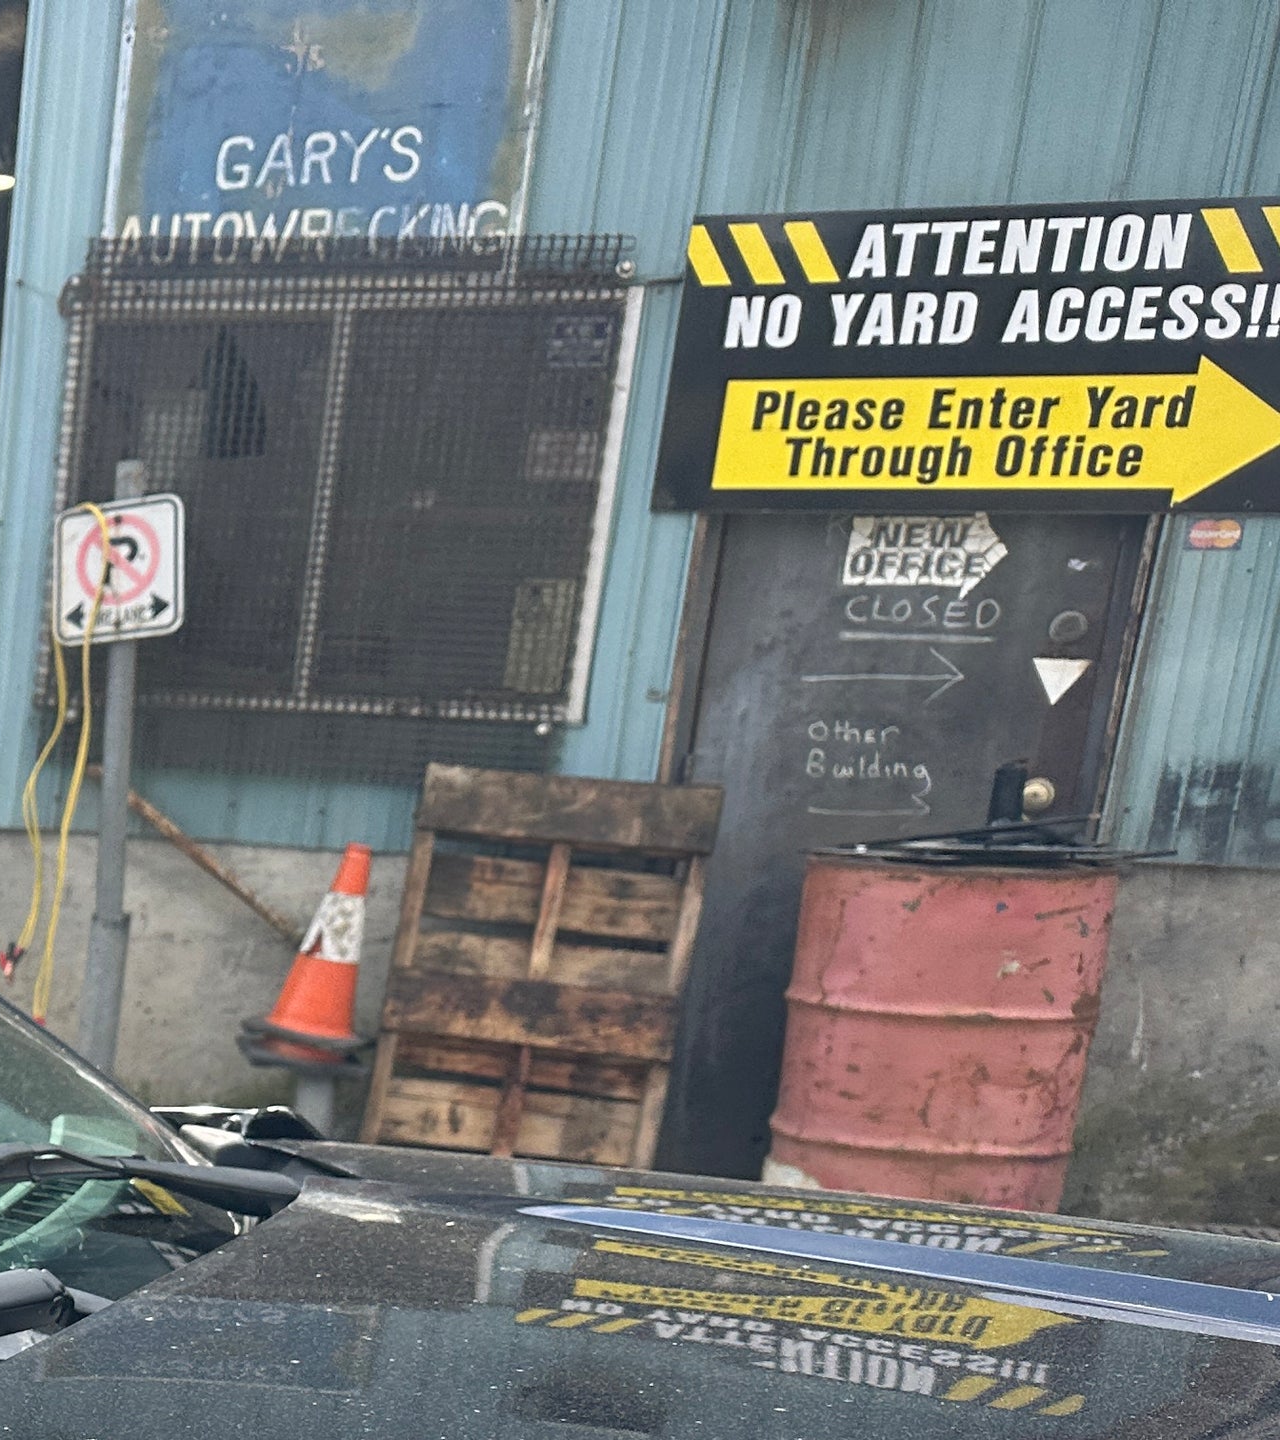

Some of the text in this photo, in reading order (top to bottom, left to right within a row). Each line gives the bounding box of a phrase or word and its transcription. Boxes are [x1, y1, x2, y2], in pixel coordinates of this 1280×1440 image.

[215, 126, 424, 191] GARY'S
[847, 213, 1193, 279] ATTENTION
[723, 294, 803, 349] NO
[831, 291, 979, 348] YARD
[751, 384, 1197, 431] Please Enter Yard
[785, 434, 1144, 484] Through Office
[874, 521, 969, 549] NEW
[849, 547, 987, 579] OFFICE
[845, 595, 1001, 629] CLOSED
[807, 720, 900, 744] Other
